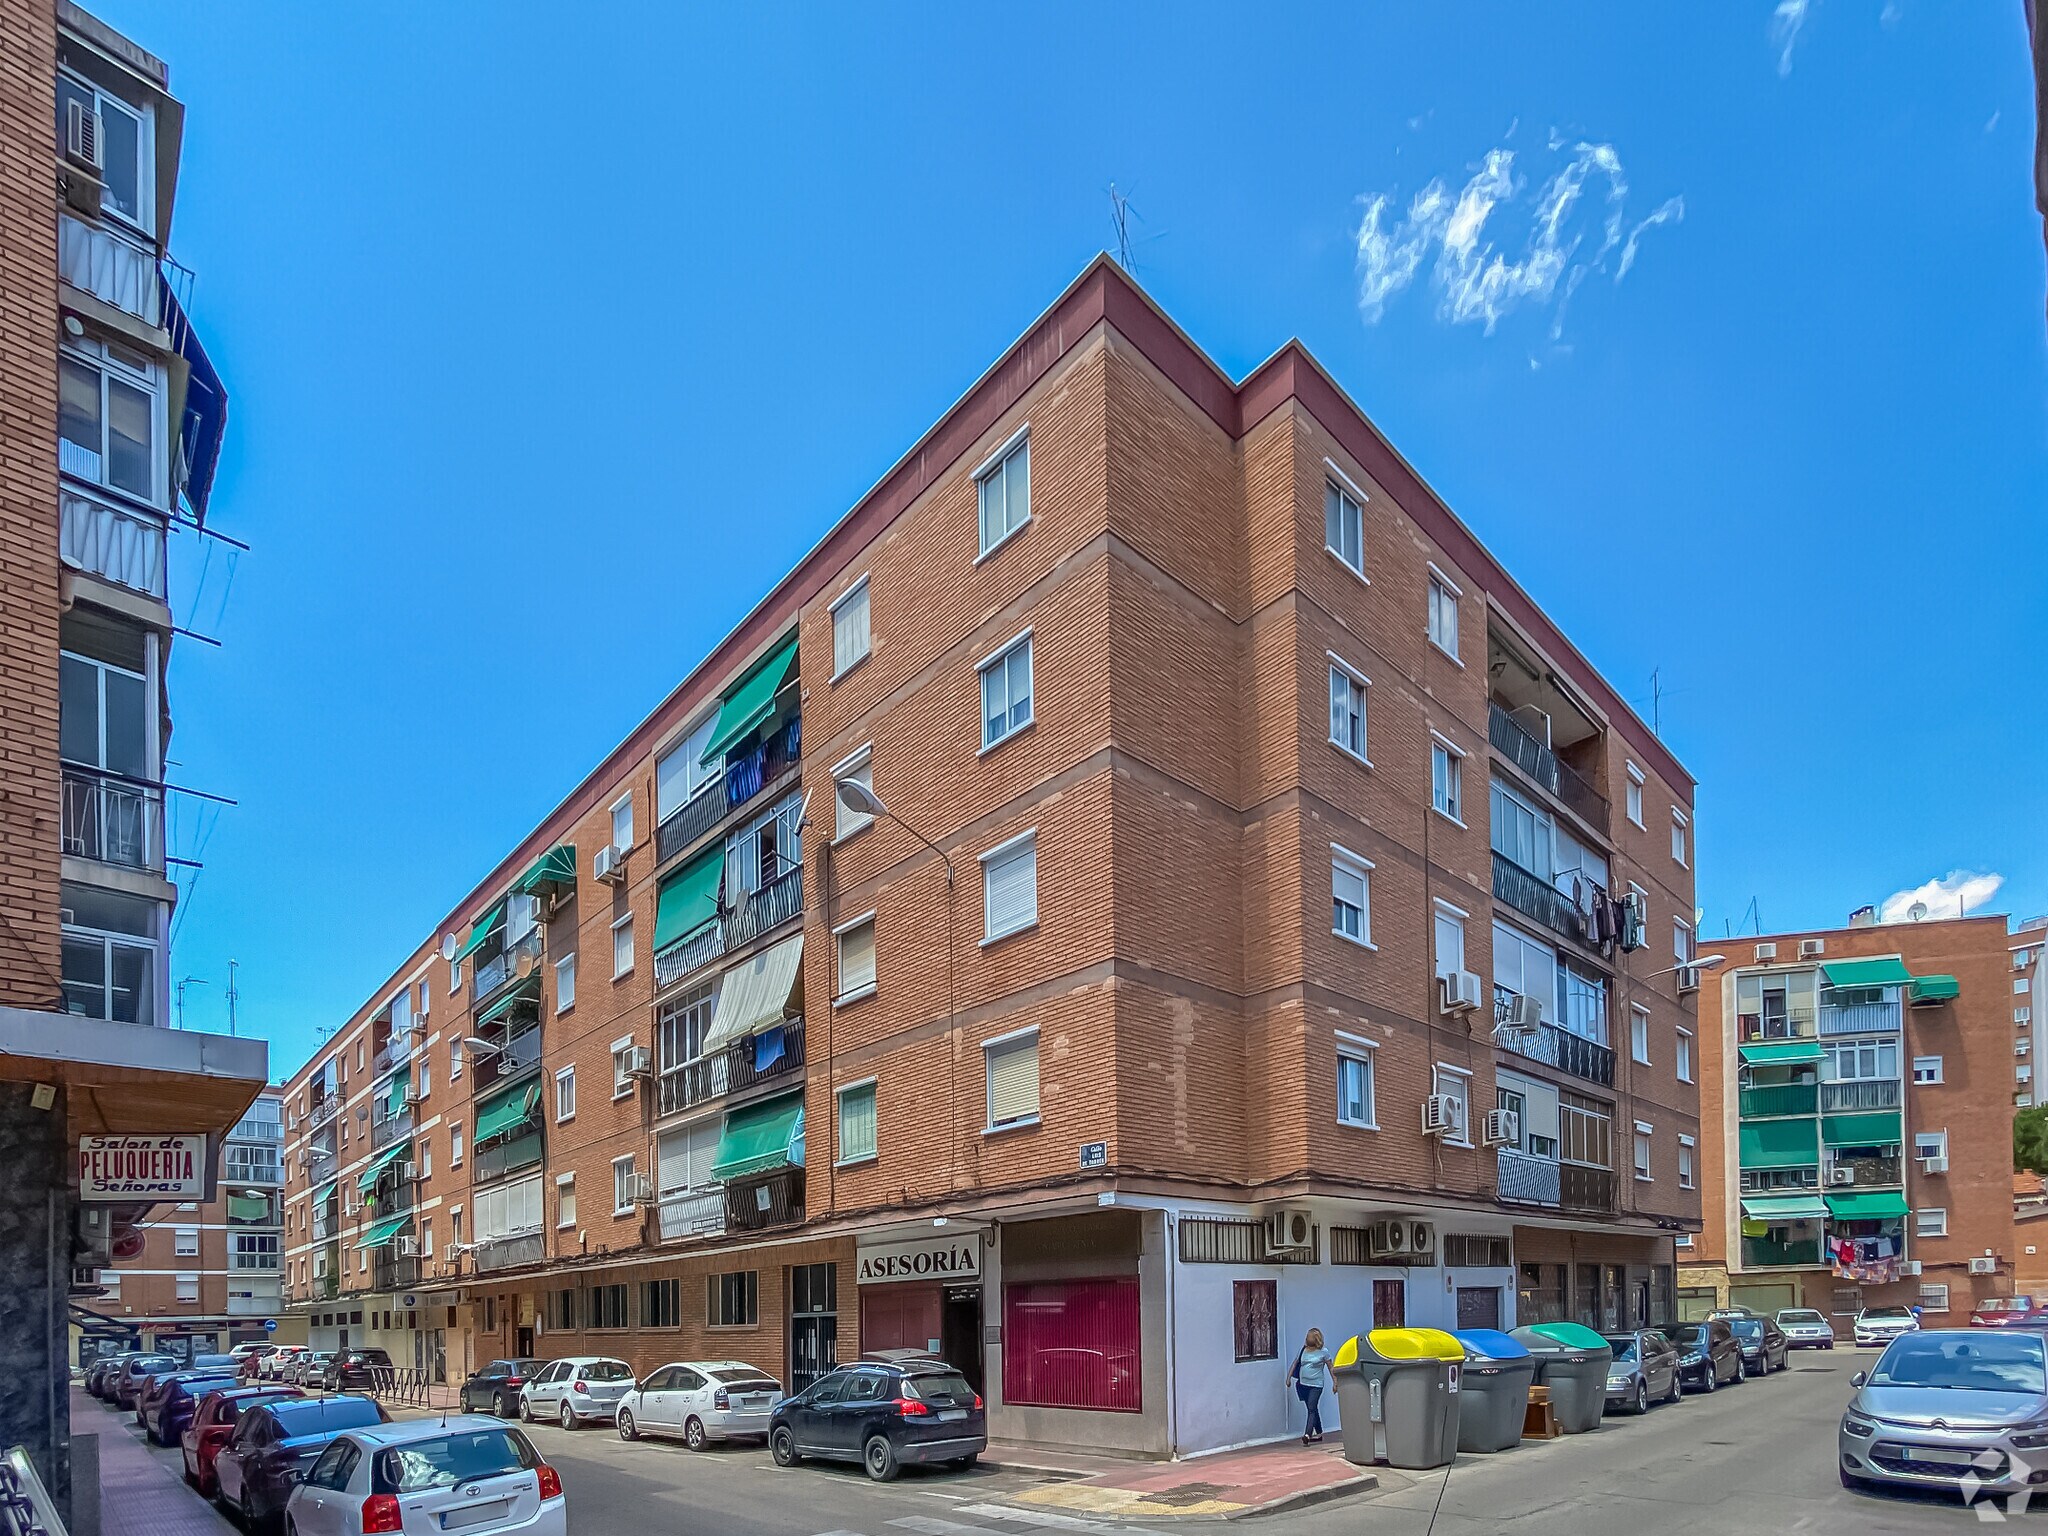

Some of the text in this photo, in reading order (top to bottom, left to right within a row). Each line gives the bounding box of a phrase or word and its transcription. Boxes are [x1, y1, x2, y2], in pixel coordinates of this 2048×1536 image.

[88, 1136, 184, 1150] Salon de
[80, 1150, 193, 1180] PELUQUERIA
[91, 1180, 182, 1192] Señoras
[859, 1244, 975, 1278] ASESORÍA
